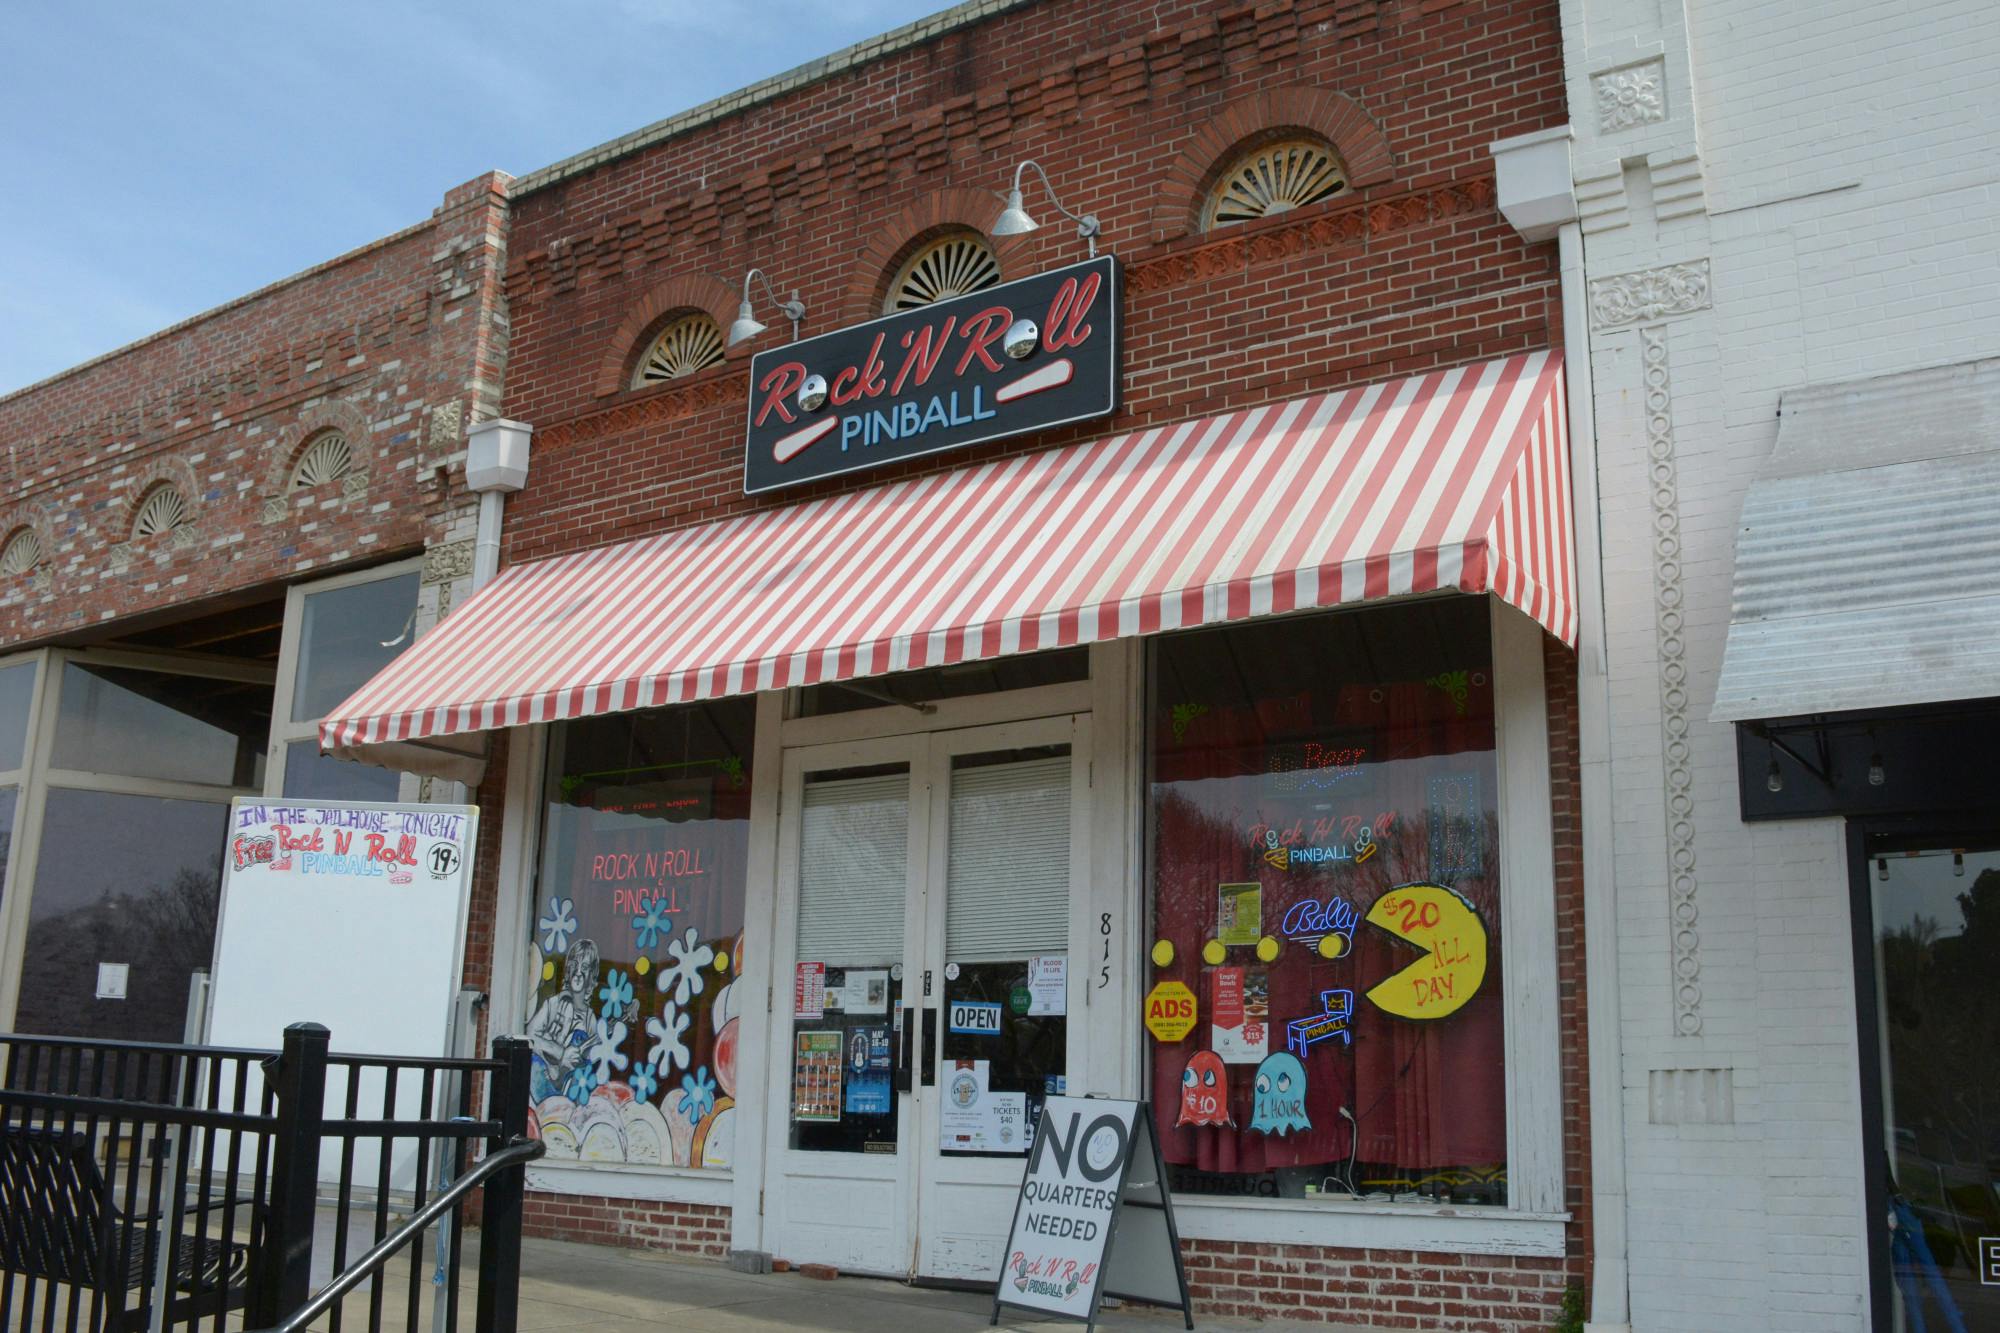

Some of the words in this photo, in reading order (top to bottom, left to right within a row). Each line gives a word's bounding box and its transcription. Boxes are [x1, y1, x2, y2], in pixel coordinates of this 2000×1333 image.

[754, 331, 887, 428] Rock
[954, 271, 1102, 377] Roll
[841, 385, 996, 452] PINBALL
[238, 804, 267, 828] IN
[272, 807, 307, 825] THE
[395, 812, 465, 841] TONIGHT
[270, 824, 324, 852] Rock
[364, 833, 418, 867] Roll
[431, 846, 458, 873] 19+
[1290, 845, 1352, 863] PINBALL
[302, 852, 383, 876] PINBALL
[592, 853, 640, 880] ROCK
[662, 848, 704, 876] ROLL
[1282, 896, 1359, 940] Bally
[1383, 896, 1441, 934] $20
[1433, 937, 1470, 969] ALL
[1413, 972, 1454, 1007] DAY
[955, 1007, 997, 1029] OPEN
[1149, 999, 1193, 1018] ADS
[871, 1030, 884, 1038] MAY
[1305, 1018, 1346, 1039] PINBALL
[992, 1107, 1021, 1115] TICKETS
[1000, 1116, 1013, 1124] $40
[1257, 1100, 1268, 1118] 1
[1271, 1097, 1305, 1118] HOUR
[1028, 1108, 1129, 1183] NO
[1024, 1180, 1117, 1212] QUARTERS
[1025, 1212, 1098, 1242] NEEDED
[1028, 1278, 1063, 1298] PINBALL
